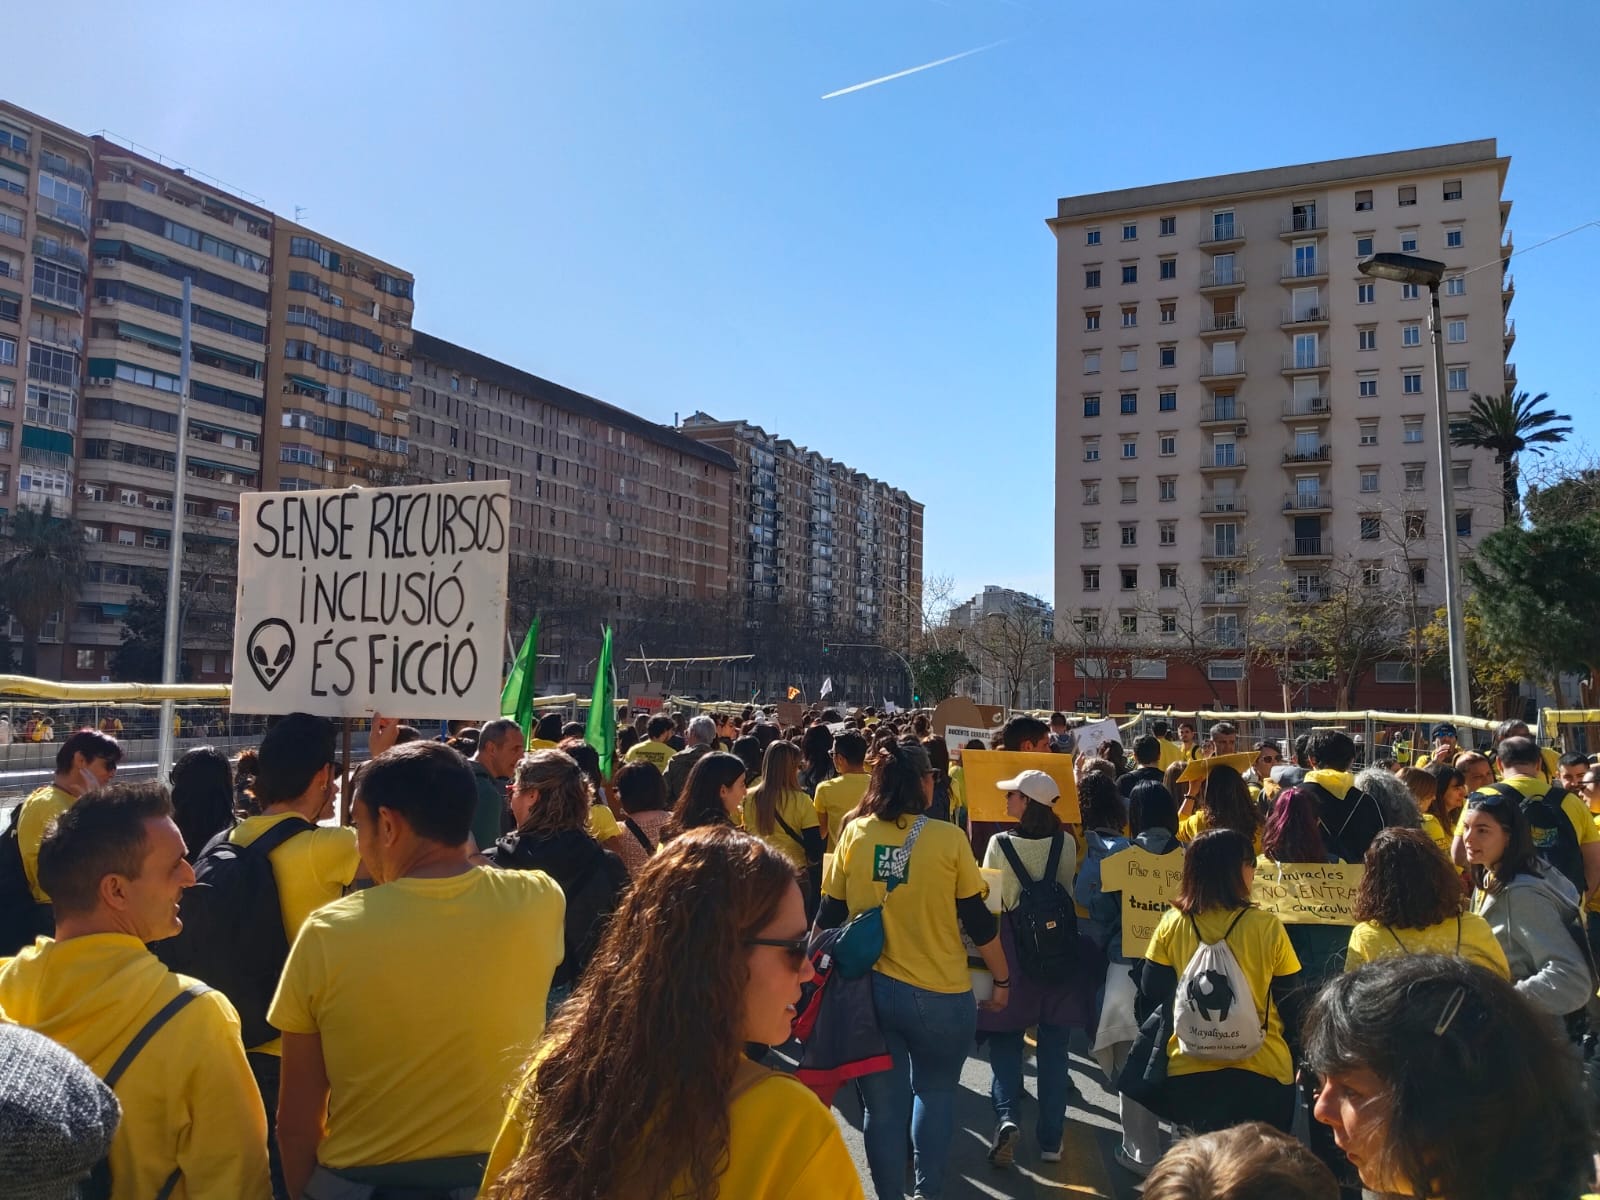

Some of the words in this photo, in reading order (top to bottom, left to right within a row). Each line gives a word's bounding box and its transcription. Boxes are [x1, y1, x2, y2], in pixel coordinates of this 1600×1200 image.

[253, 493, 359, 560] SENSE
[369, 492, 507, 559] RECURSOS
[311, 628, 358, 697] ÉS
[1282, 866, 1344, 881] miracles
[1262, 885, 1288, 899] NO
[1266, 903, 1280, 914] al
